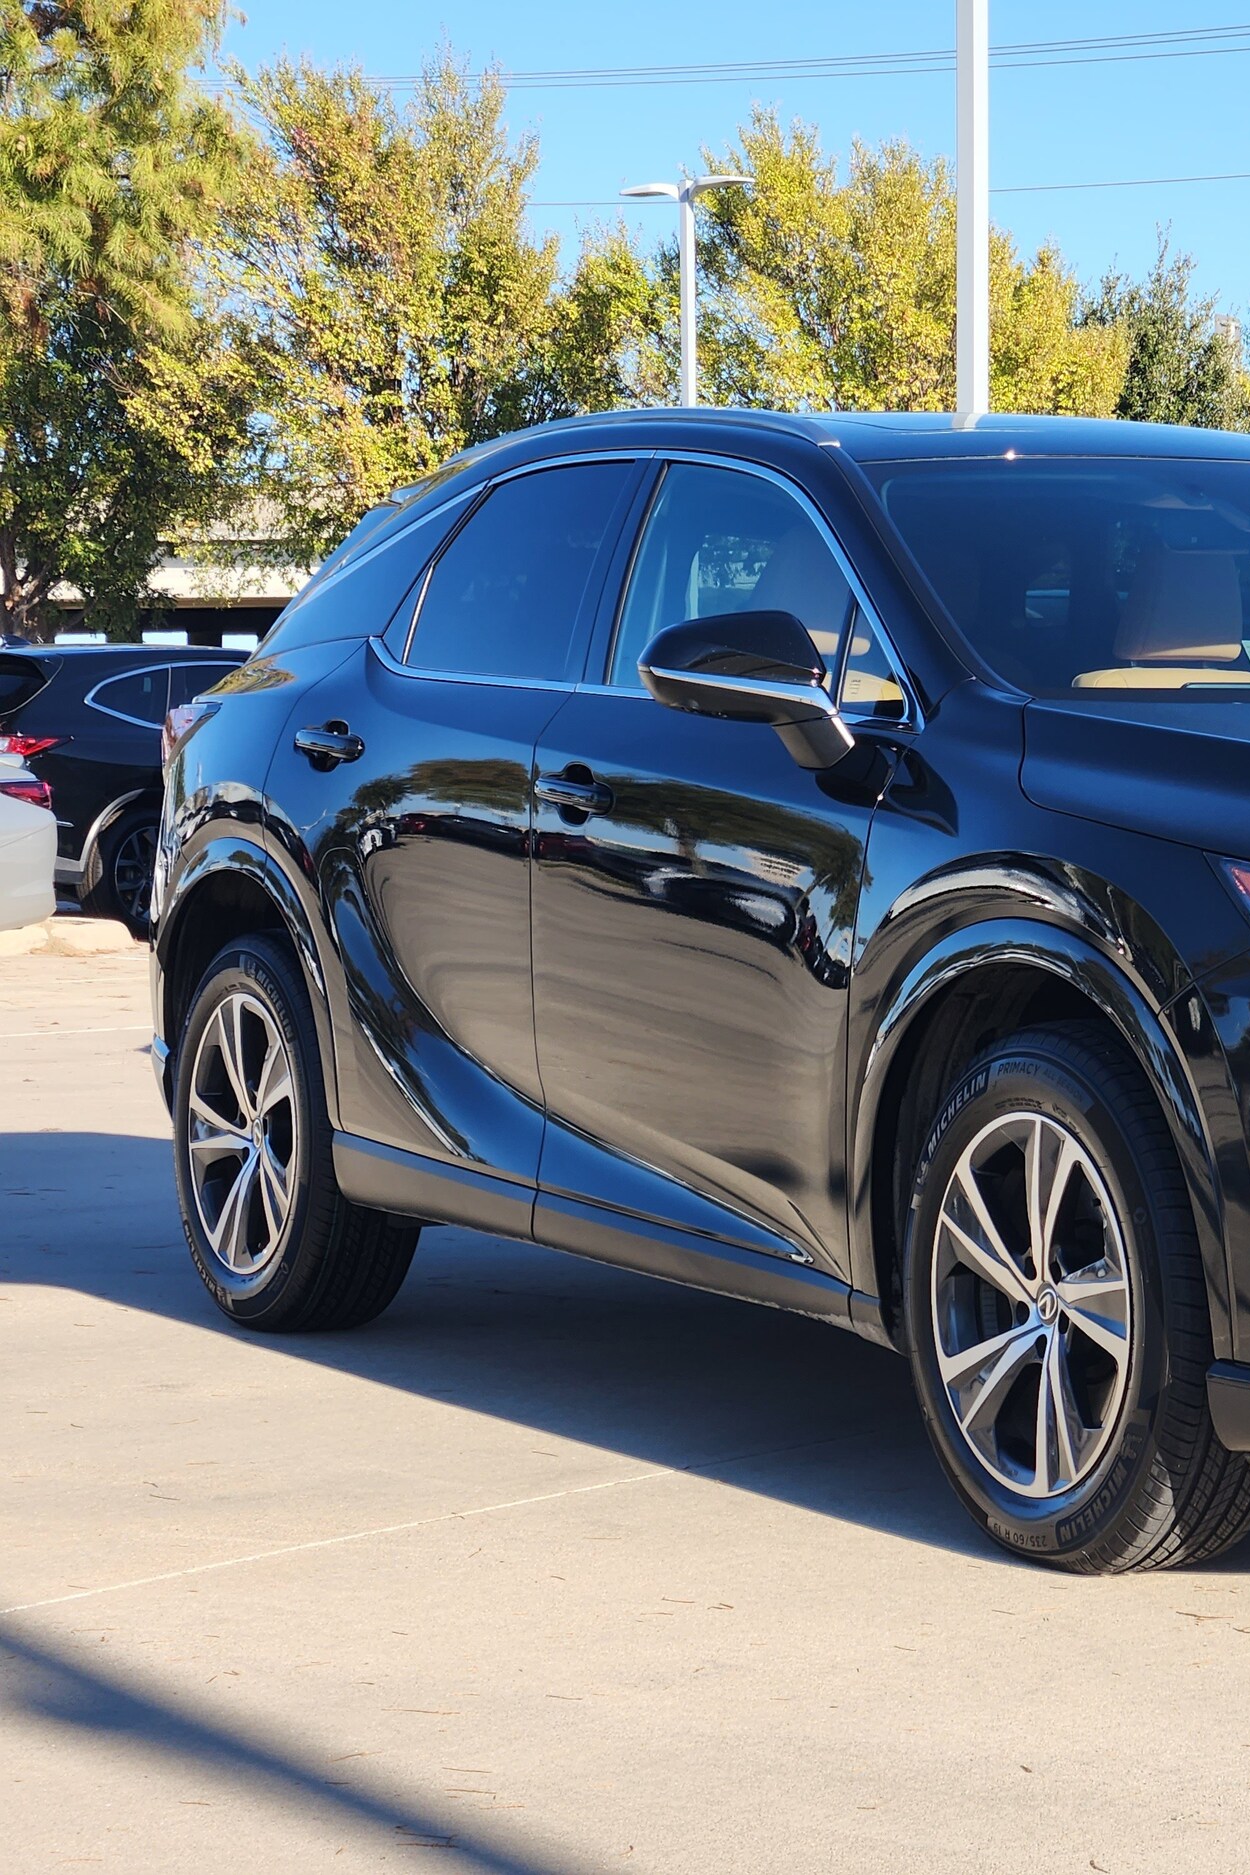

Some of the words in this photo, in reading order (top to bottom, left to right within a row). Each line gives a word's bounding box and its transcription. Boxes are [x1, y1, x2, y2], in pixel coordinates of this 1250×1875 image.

[256, 969, 294, 1039] MICHELIN
[997, 1061, 1041, 1077] PRIMACY
[927, 1071, 987, 1159] MICHELIN
[1060, 1461, 1128, 1543] MICHELIN
[1004, 1528, 1011, 1537] R
[1013, 1532, 1047, 1548] 235/60
